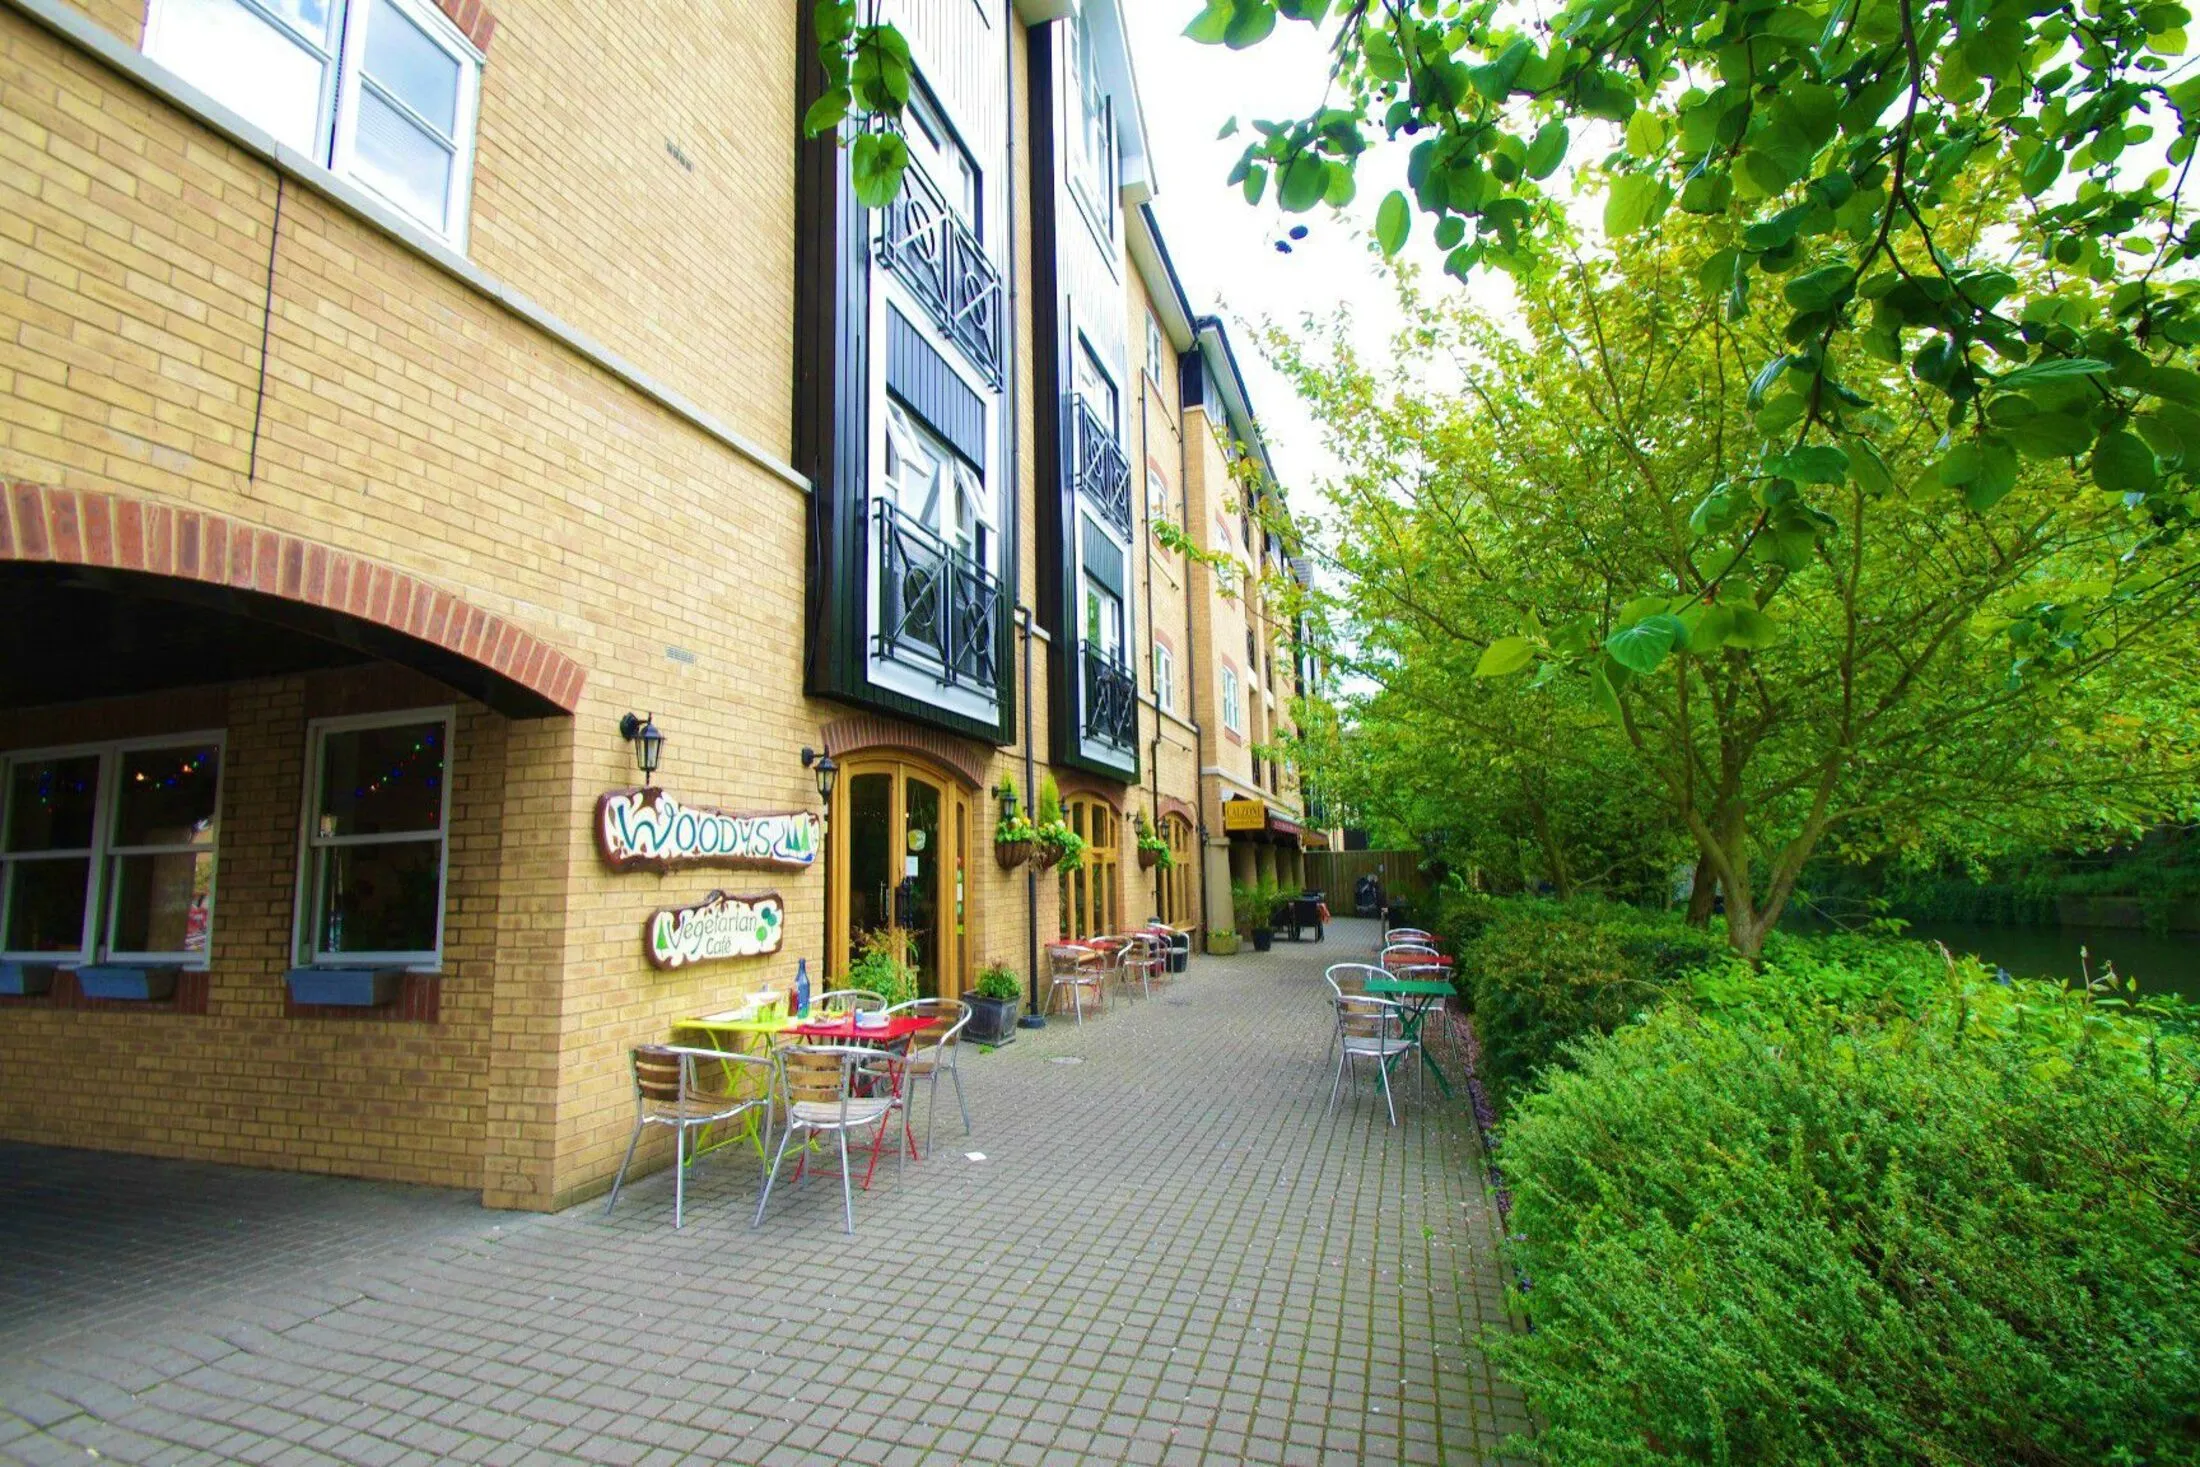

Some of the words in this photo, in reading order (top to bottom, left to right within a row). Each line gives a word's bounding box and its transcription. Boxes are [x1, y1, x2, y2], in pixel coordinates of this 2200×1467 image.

[617, 801, 771, 856] WOODYS
[667, 911, 758, 955] Vegetarian
[705, 936, 732, 956] Café
